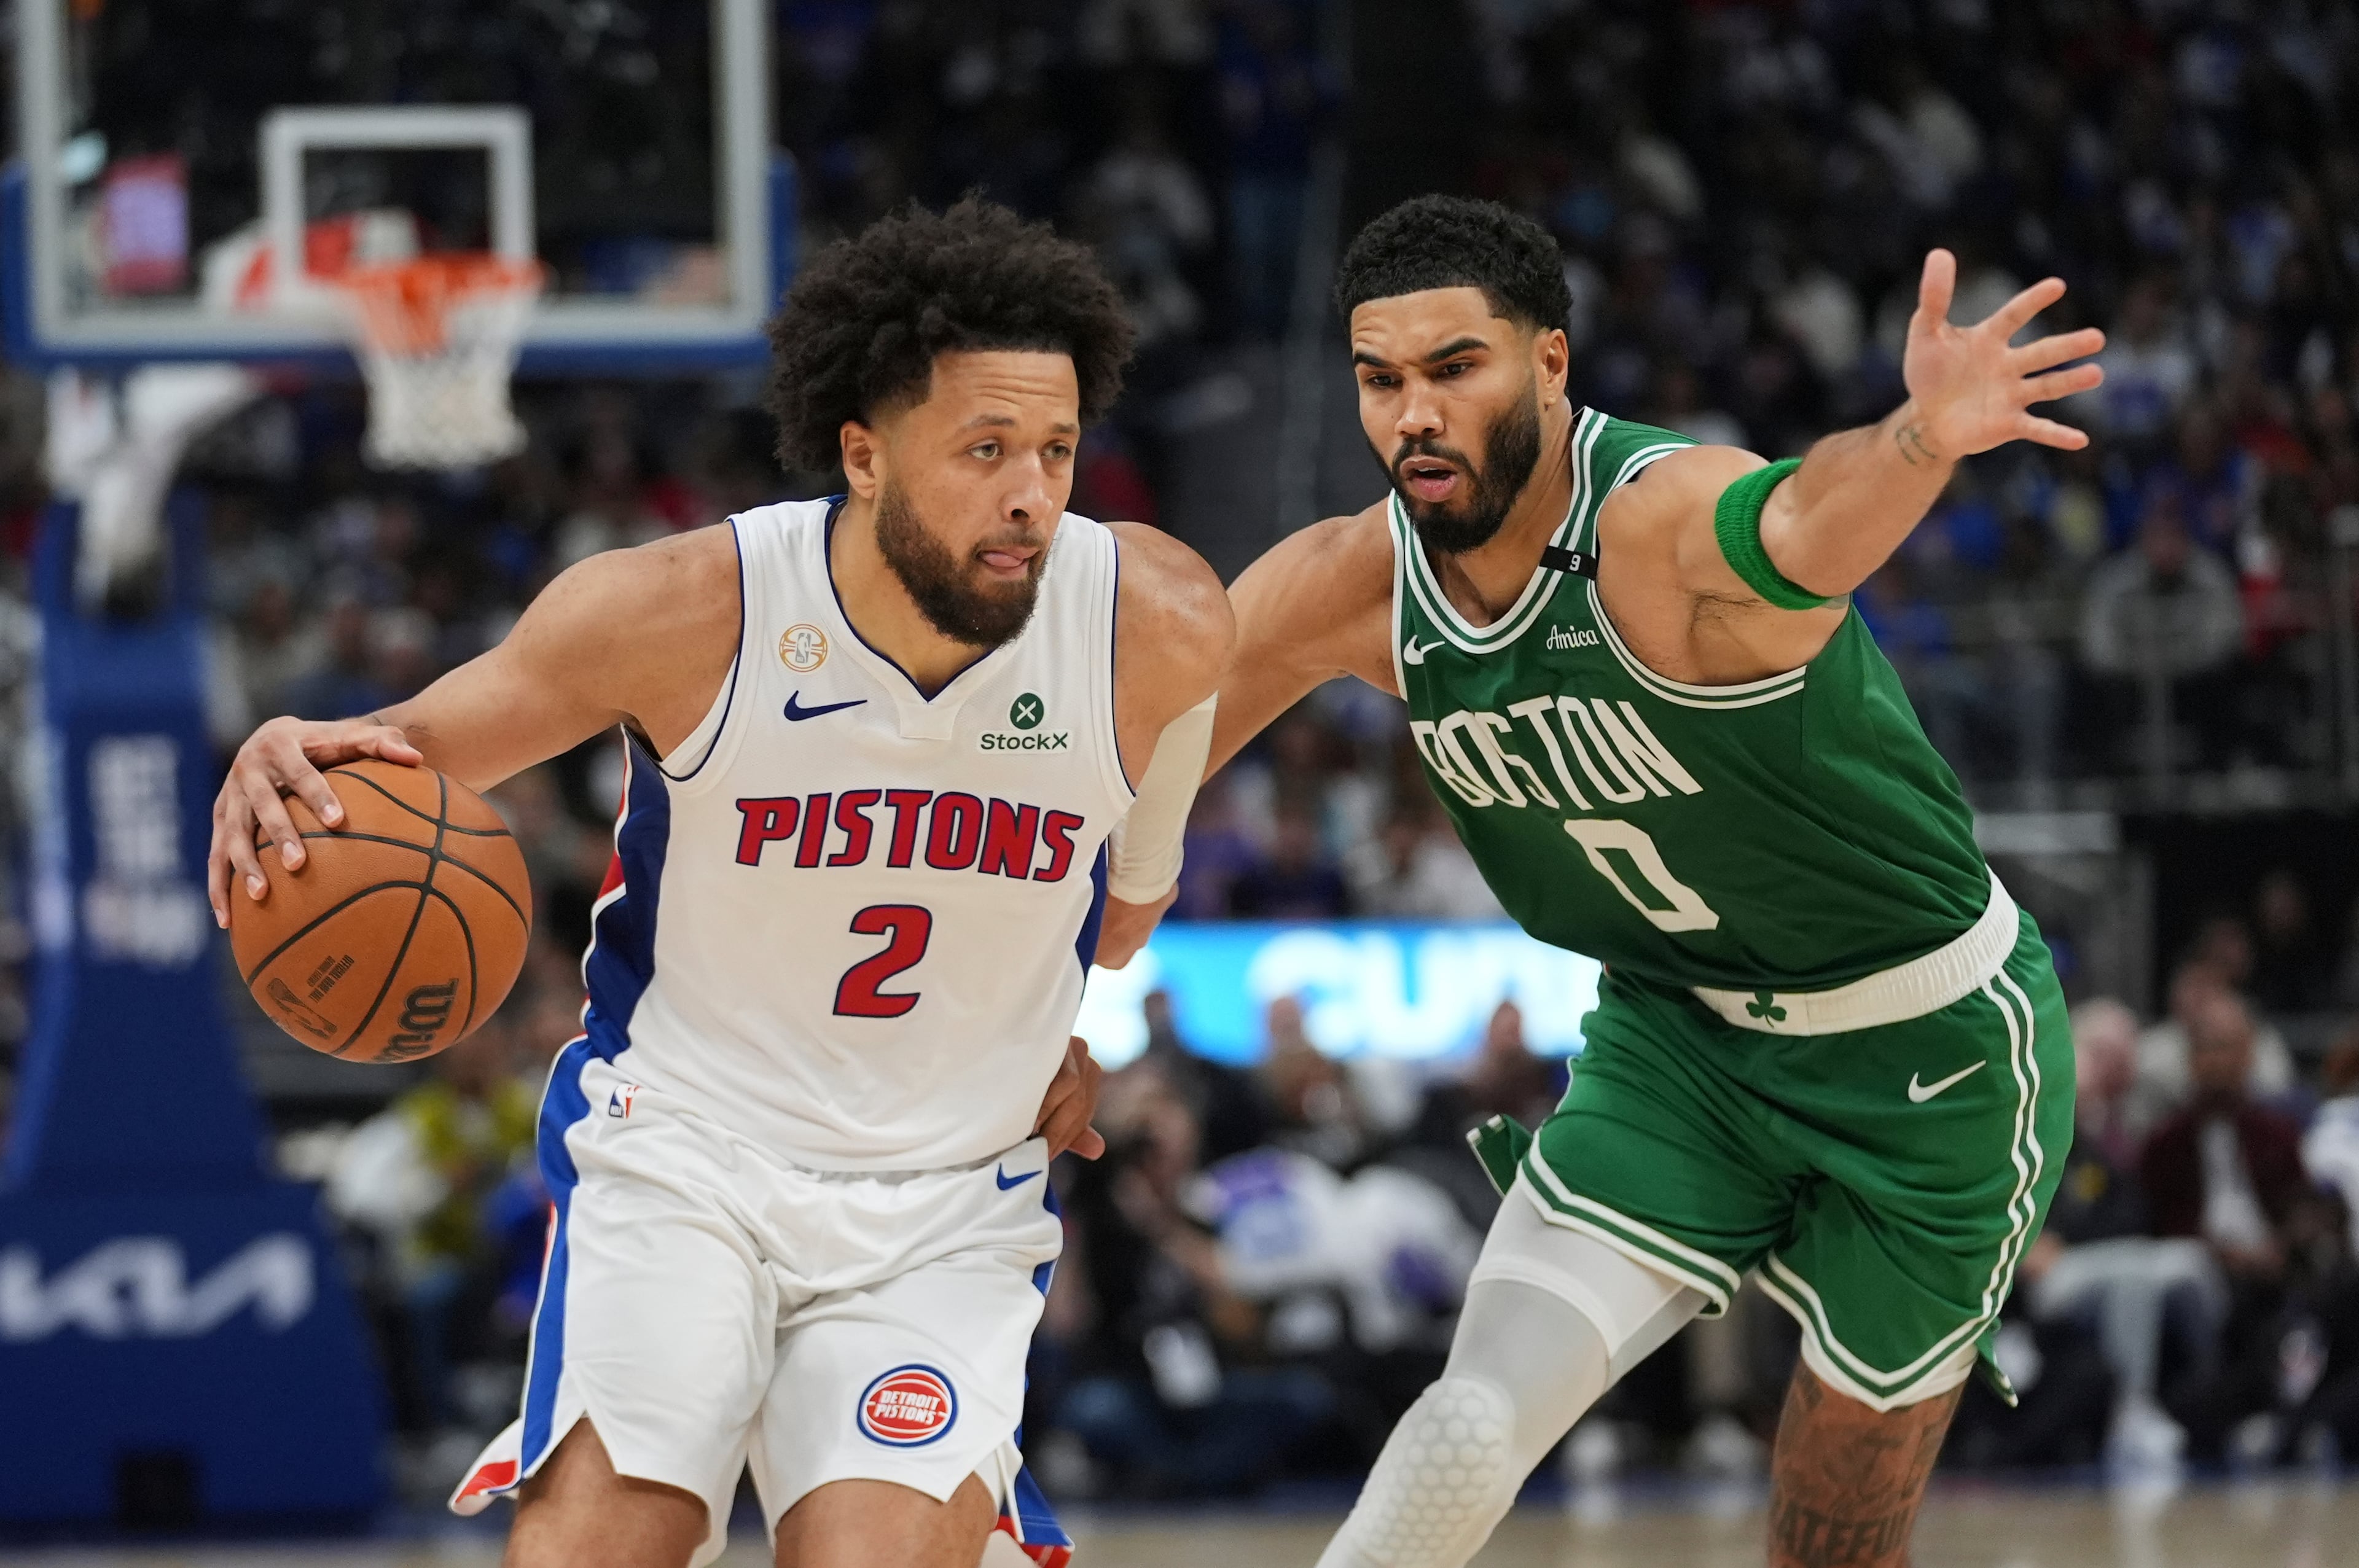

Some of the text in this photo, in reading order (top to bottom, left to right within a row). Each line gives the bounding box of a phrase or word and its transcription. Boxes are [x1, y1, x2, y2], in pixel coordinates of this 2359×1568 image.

[1570, 554, 1581, 572] 9
[1546, 624, 1600, 650] Amica
[980, 732, 1068, 750] StockX
[1409, 695, 1704, 811] BOSTON
[735, 789, 1084, 883] PISTONS
[1563, 819, 1719, 932] 0
[833, 904, 933, 1018] 2
[880, 1391, 941, 1411] DETROIT
[874, 1404, 936, 1425] PISTONS
